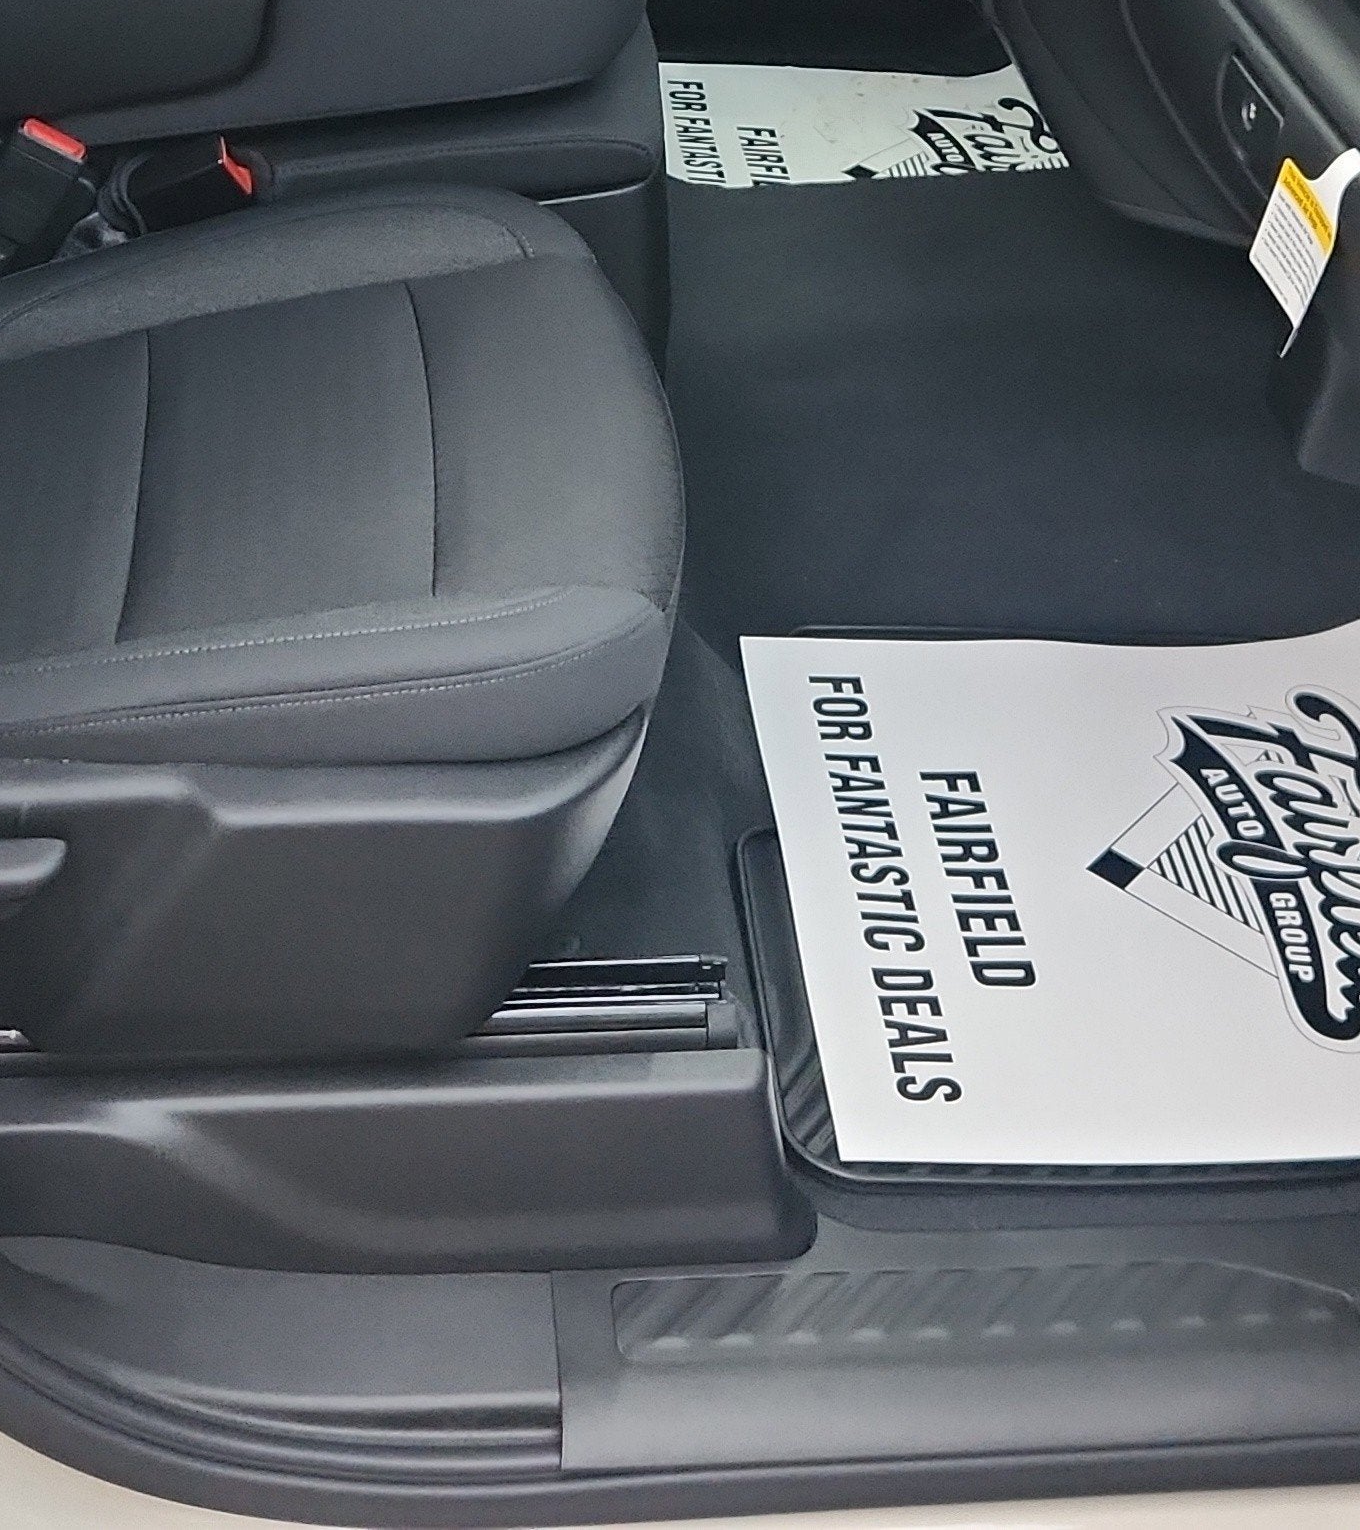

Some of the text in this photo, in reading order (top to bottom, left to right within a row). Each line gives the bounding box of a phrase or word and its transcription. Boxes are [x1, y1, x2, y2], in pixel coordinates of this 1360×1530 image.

[667, 79, 708, 112] FOR
[926, 132, 965, 163] AUTO
[808, 674, 963, 1104] FOR FANTASTIC DEALS
[919, 770, 1038, 988] FAIRFIELD
[1200, 767, 1317, 984] AUTO GROUP
